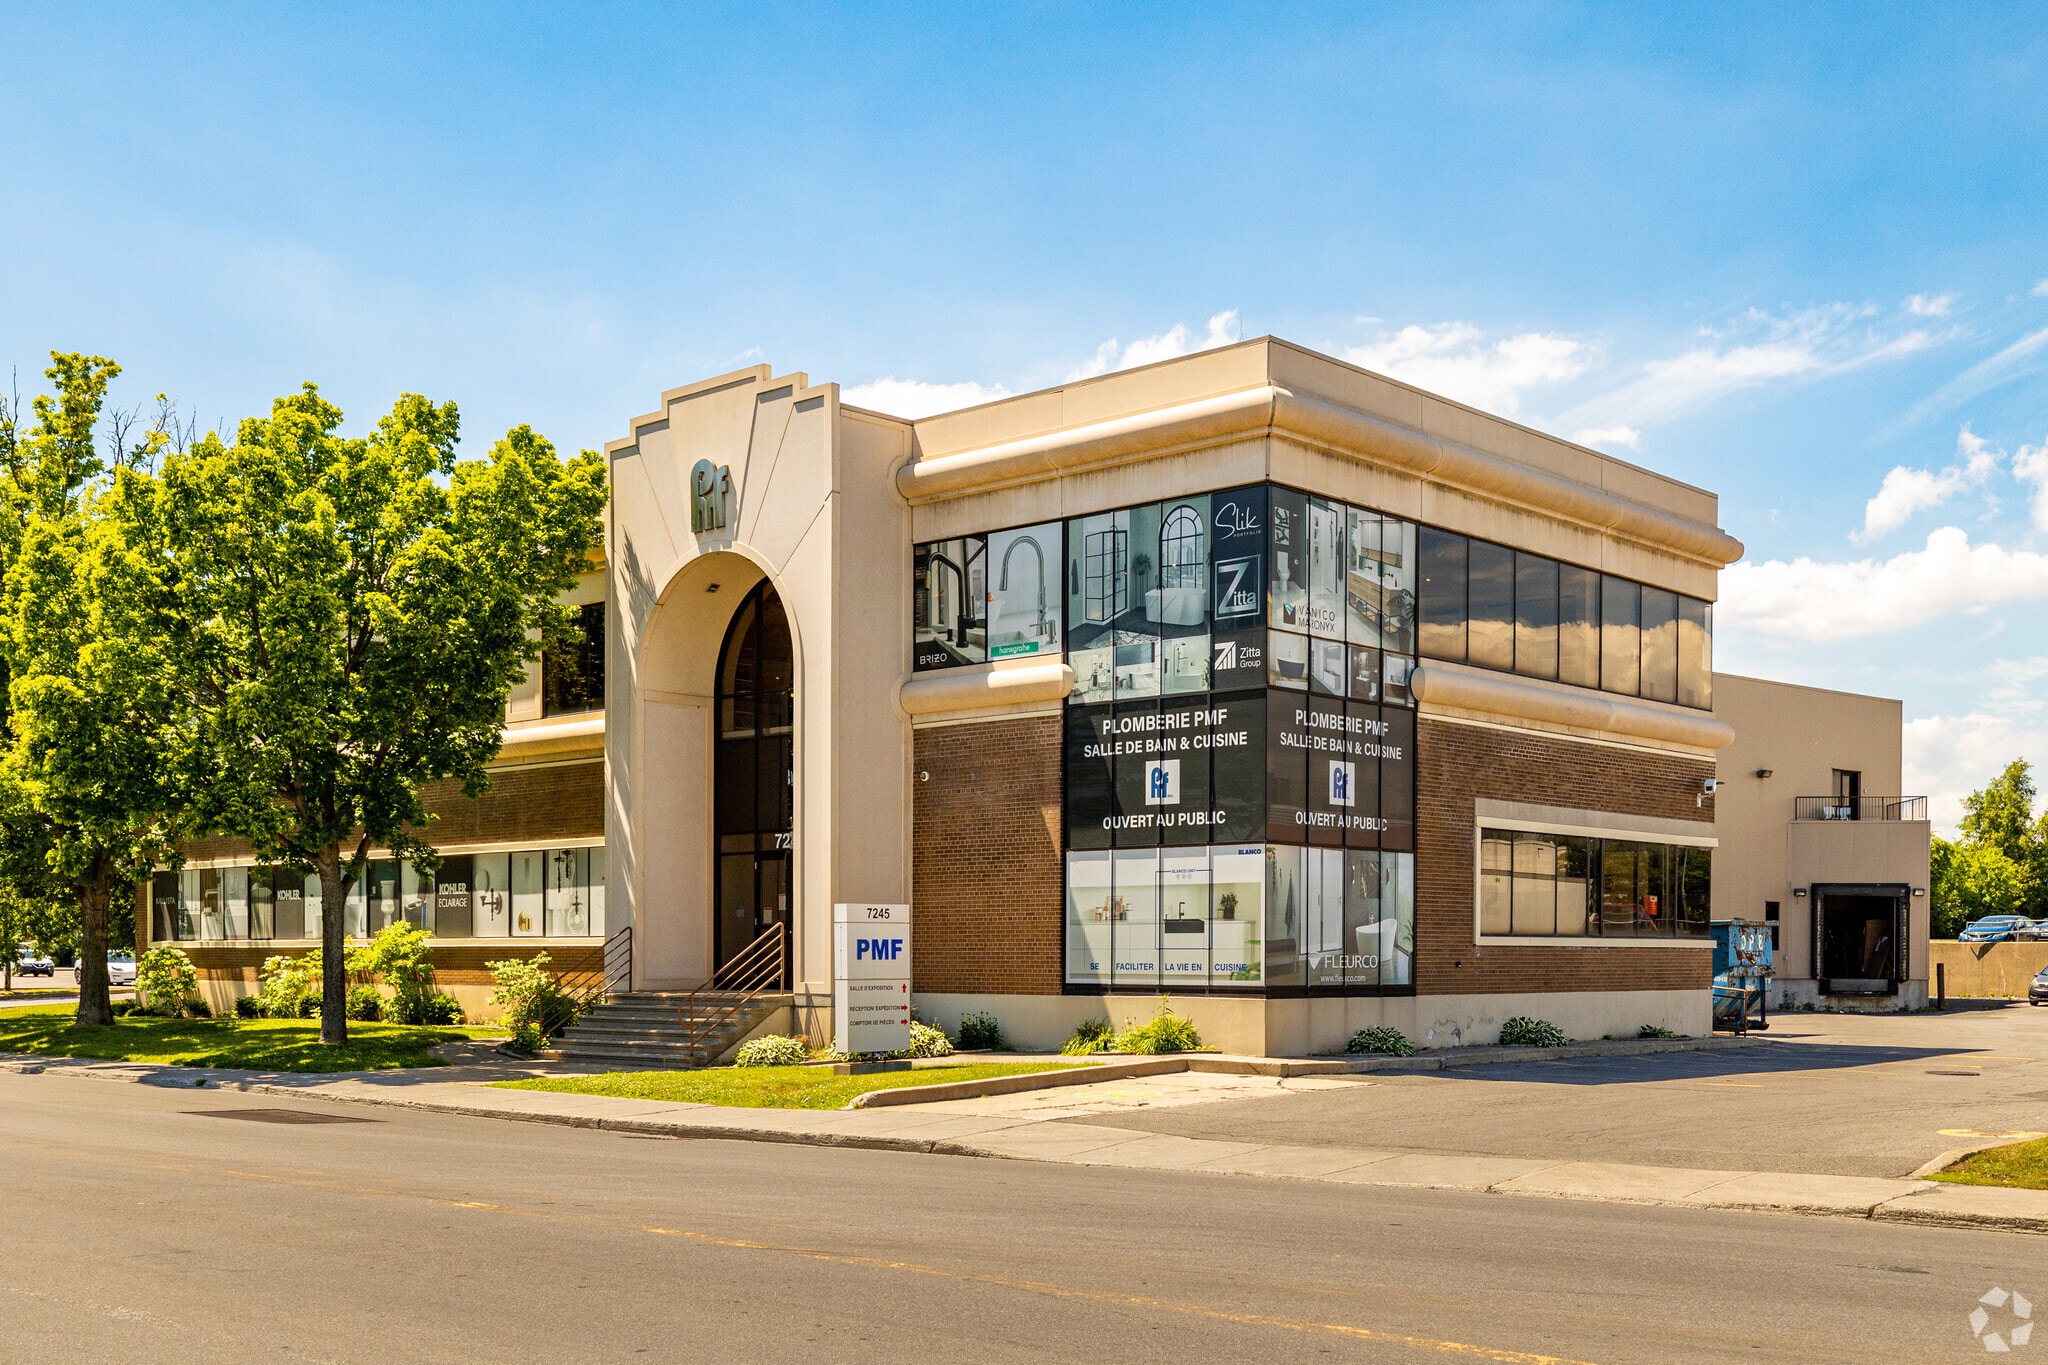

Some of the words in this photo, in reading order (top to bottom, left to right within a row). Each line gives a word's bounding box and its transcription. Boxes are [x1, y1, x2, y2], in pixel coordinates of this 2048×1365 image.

[1215, 502, 1260, 540] Slik
[1233, 529, 1261, 538] PORTFOLIO
[1218, 561, 1257, 614] Zitta
[1299, 605, 1336, 622] VANICO
[1298, 617, 1336, 633] MARONYX
[999, 644, 1030, 655] hansgrohe
[1240, 647, 1261, 659] Zitta
[1240, 659, 1261, 669] Group
[1102, 712, 1190, 735] PLOMBERIE
[1194, 708, 1228, 727] PMF
[1295, 709, 1362, 734] PLOMBERIE
[1365, 719, 1389, 737] PMF
[1084, 742, 1123, 758] SALLE
[1126, 740, 1143, 755] DE
[1145, 737, 1177, 753] BAIN
[1180, 736, 1190, 750] &
[1193, 731, 1248, 749] CUISINE
[1280, 732, 1312, 748] SALLE
[1314, 736, 1327, 751] DE
[1329, 738, 1352, 754] BAIN
[1355, 741, 1362, 755] &
[1364, 743, 1402, 760] CUISINE
[1102, 814, 1154, 830] OUVERT
[1156, 813, 1175, 827] AU
[1178, 810, 1226, 826] PUBLIC
[1295, 811, 1336, 827] OUVERT
[1337, 815, 1351, 828] AU
[1353, 816, 1388, 831] PUBLIC
[774, 833, 793, 849] 72
[1238, 848, 1262, 856] BLANCO
[866, 907, 890, 919] 7245
[856, 938, 904, 961] PMF
[1089, 962, 1100, 971] SE
[1115, 962, 1154, 971] FACILITER
[1164, 963, 1175, 971] LA
[1176, 963, 1190, 971] VIE
[1191, 963, 1202, 971] EN
[1214, 963, 1247, 971] CUISINE
[1324, 954, 1379, 969] FLEURCO
